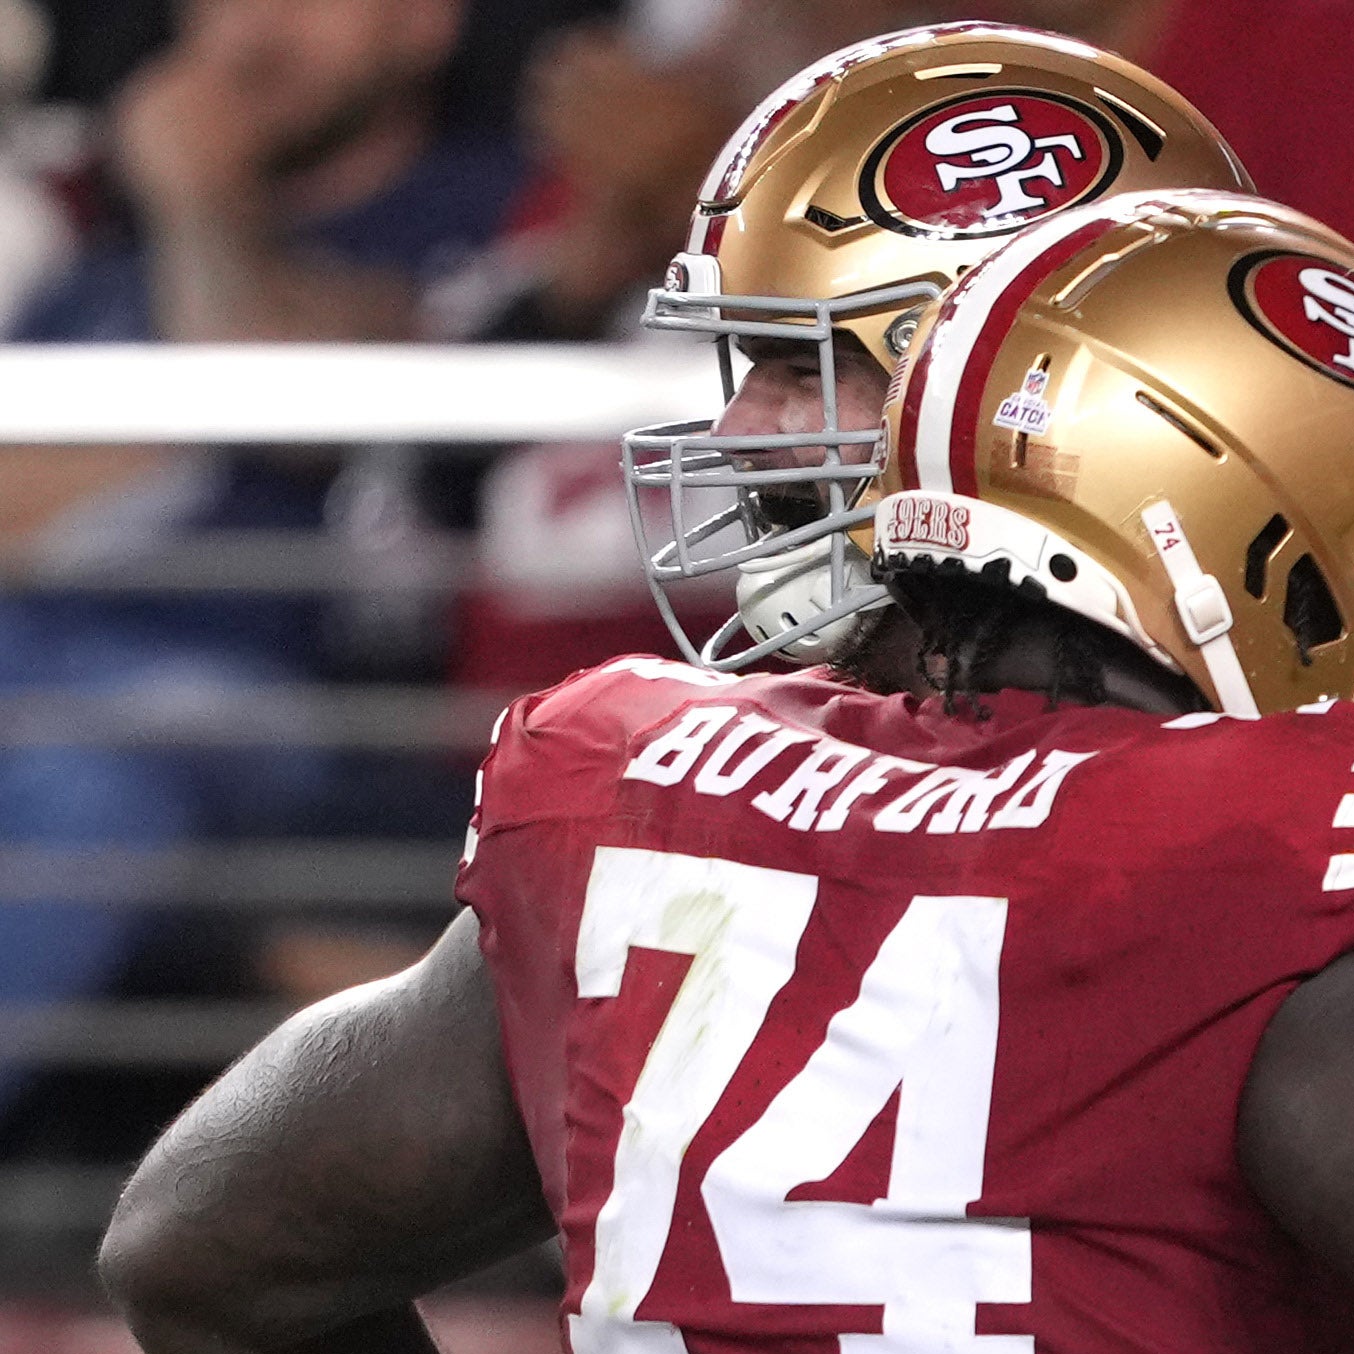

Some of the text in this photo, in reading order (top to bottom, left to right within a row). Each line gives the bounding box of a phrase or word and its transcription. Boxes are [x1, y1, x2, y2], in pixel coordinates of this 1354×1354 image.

[925, 104, 1083, 218] SF
[1154, 522, 1181, 551] 74
[622, 705, 1099, 834] BURFORD
